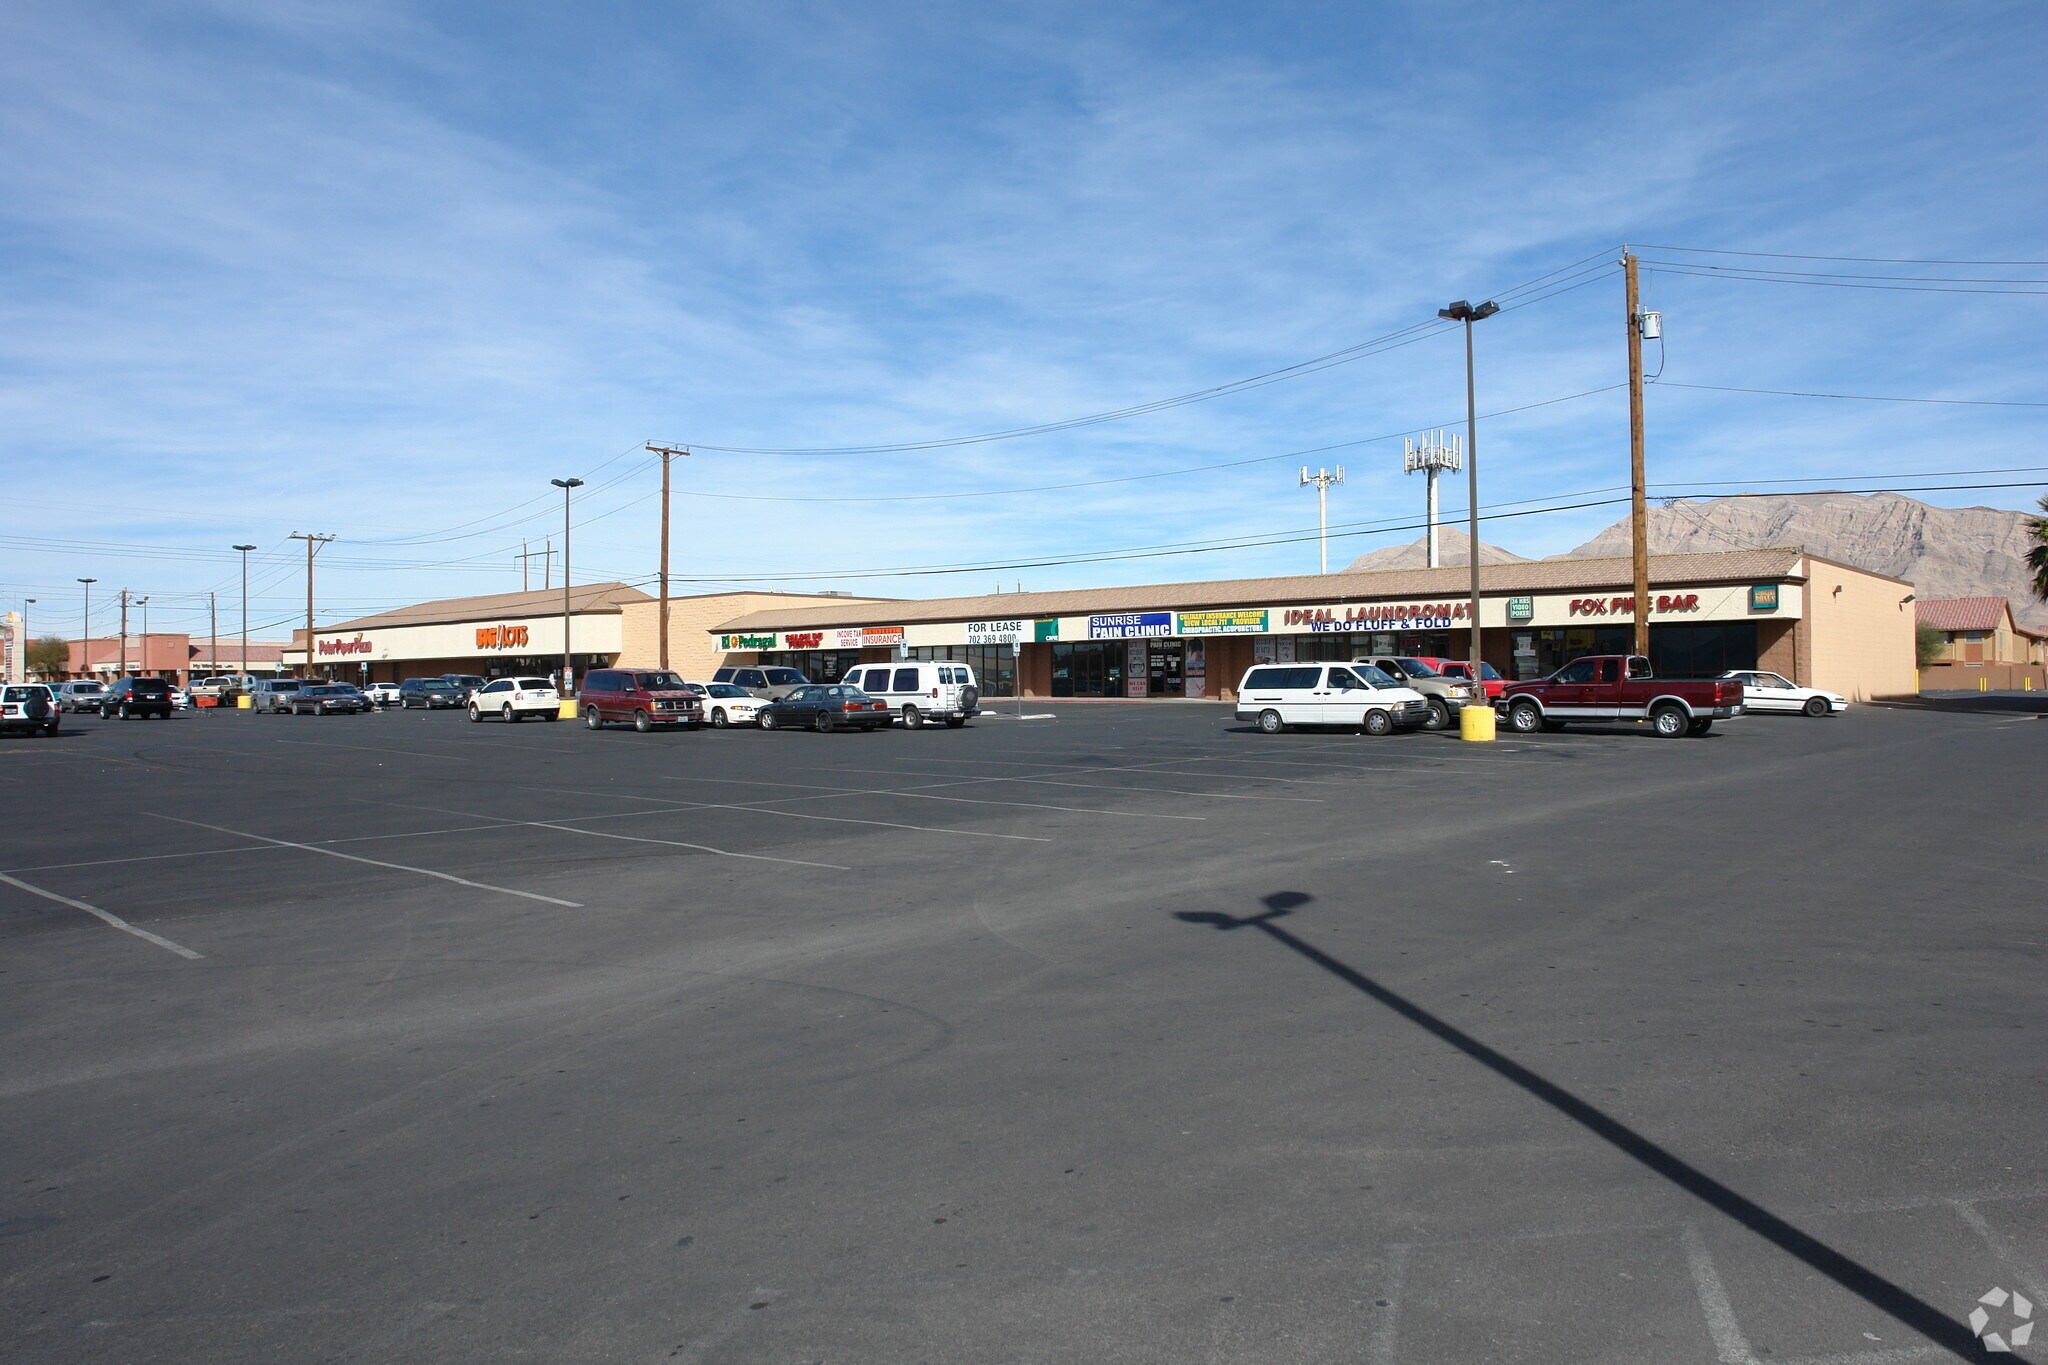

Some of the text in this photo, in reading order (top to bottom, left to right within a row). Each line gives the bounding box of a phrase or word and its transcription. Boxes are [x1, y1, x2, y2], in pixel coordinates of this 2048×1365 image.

[1569, 598, 1607, 617] FOX
[1656, 595, 1699, 613] BAR
[1237, 610, 1265, 618] WELCOME
[1284, 603, 1472, 626] IDEAL LAUNDROMAT
[1092, 615, 1141, 626] SUNRISE
[1311, 617, 1452, 632] WE DO FLUFF & FOLD
[968, 621, 1022, 633] FOR LEASE
[1092, 624, 1170, 638] PAIN CLINIC
[840, 638, 858, 647] SERVICE
[863, 634, 902, 644] INSURANCE
[968, 635, 981, 644] 702
[983, 634, 997, 644] 369
